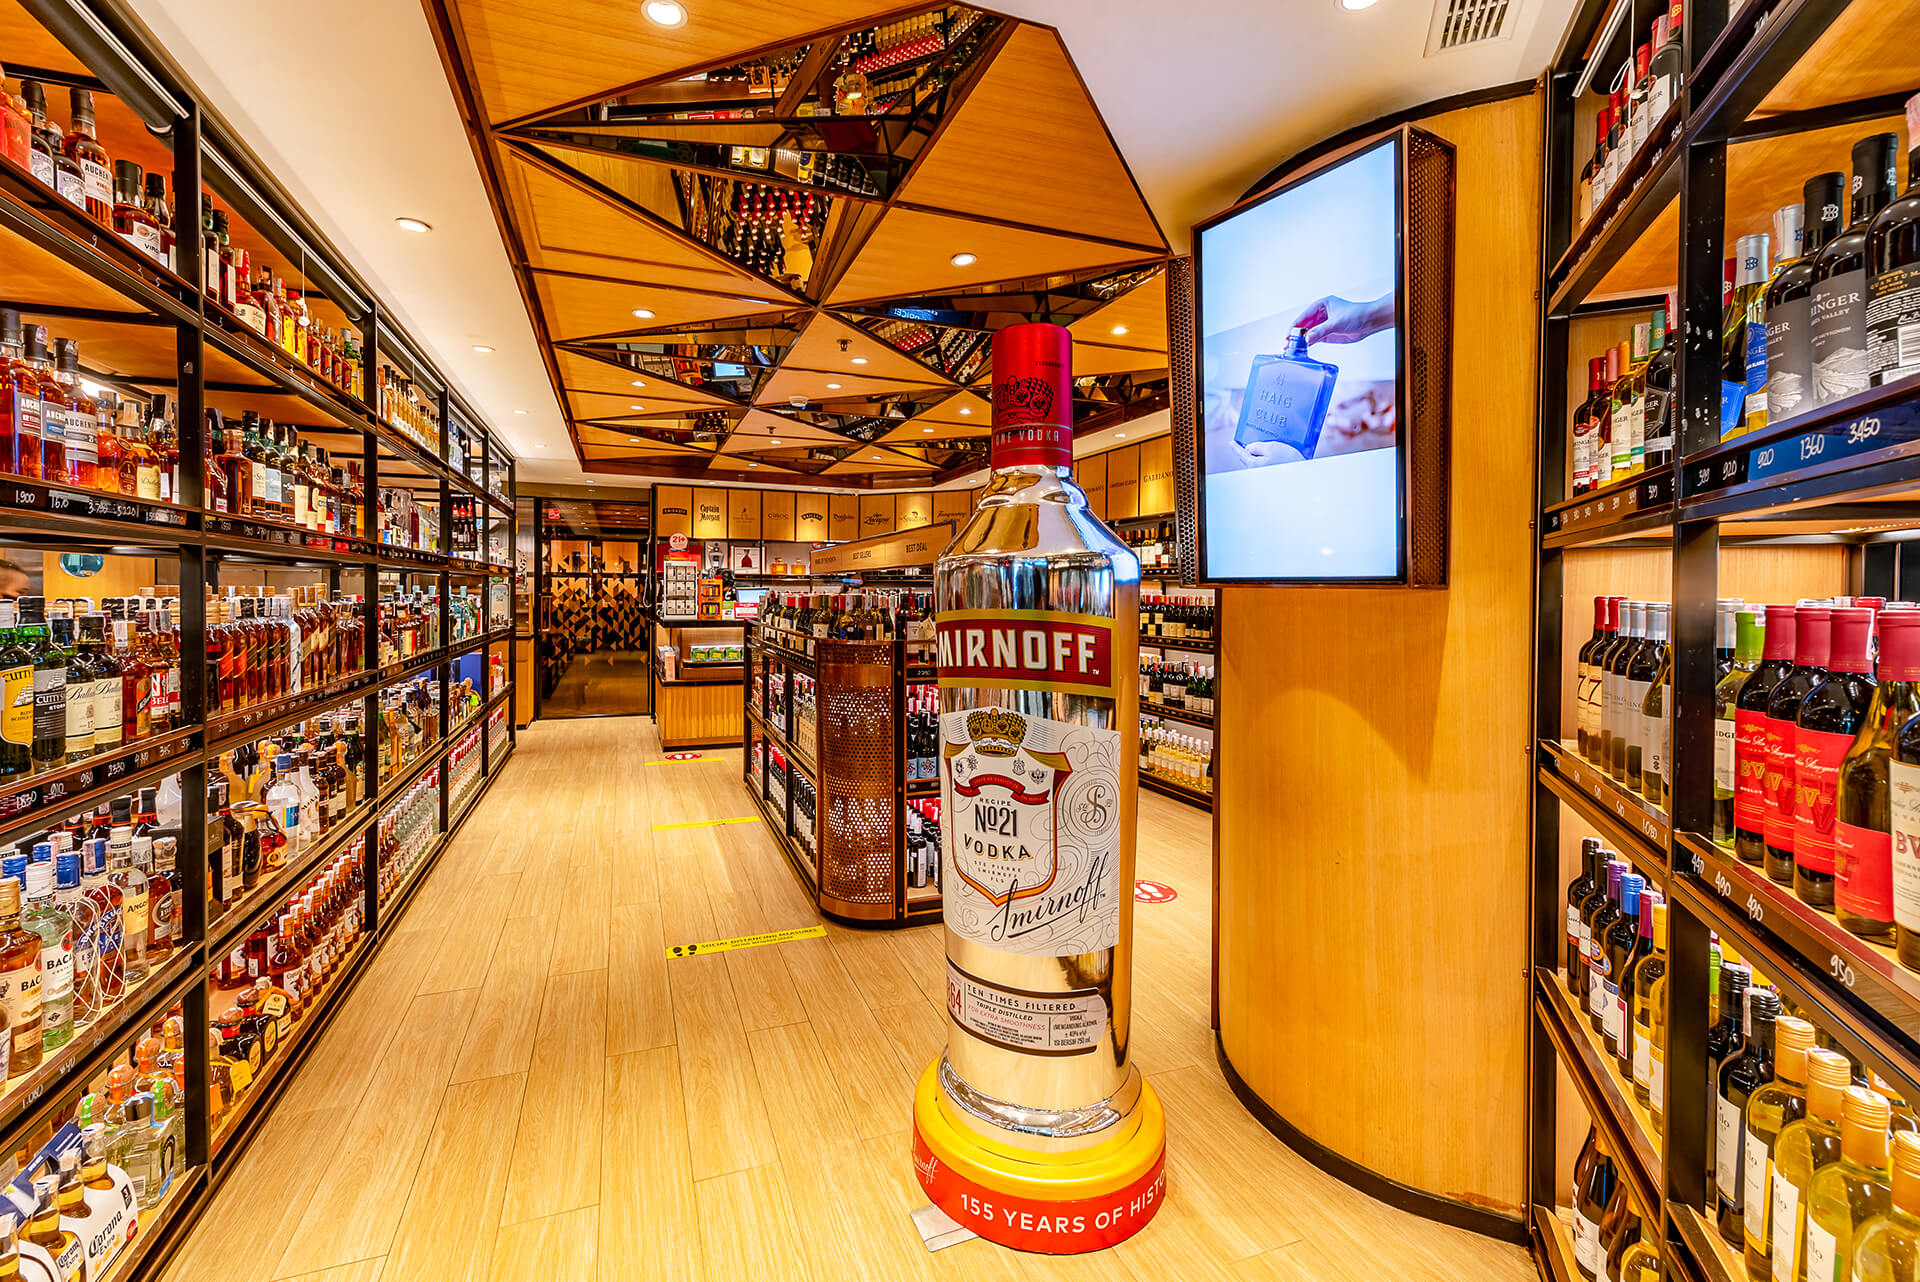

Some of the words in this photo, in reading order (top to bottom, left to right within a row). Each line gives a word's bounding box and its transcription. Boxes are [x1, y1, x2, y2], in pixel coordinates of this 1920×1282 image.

[1260, 389, 1292, 409] HAIG
[1256, 407, 1288, 428] CLUB
[1018, 429, 1059, 442] VODKA
[1758, 447, 1775, 469] 920
[699, 513, 721, 522] Morgan
[700, 504, 720, 513] Captain
[906, 543, 916, 553] BEST
[916, 542, 928, 552] DEAL
[1588, 678, 1602, 707] 7
[1740, 759, 1766, 780] BV
[980, 797, 1012, 806] RECIPE
[963, 833, 1035, 861] VODKA
[991, 863, 1021, 873] PIERRE
[986, 852, 1109, 941] Smirnoff
[701, 940, 728, 949] SOCIAL
[730, 933, 777, 945] DISTANCING
[778, 928, 818, 937] MEASURES
[1715, 871, 1731, 896] 490
[1746, 893, 1764, 922] 490
[1830, 953, 1855, 988] 950
[967, 984, 984, 997] TEN
[990, 994, 1020, 1008] TIMES
[1025, 1002, 1076, 1011] FILTERED
[976, 1001, 997, 1014] TRIPLE
[998, 1009, 1033, 1021] DISTILLED
[979, 1009, 999, 1021] EXTRA
[1000, 1015, 1046, 1031] SMOOTHNESS
[961, 1193, 994, 1220] 155
[1003, 1208, 1085, 1233] YEARS
[1095, 1206, 1123, 1229] OF
[89, 1210, 123, 1259] Corona
[97, 1234, 116, 1255] Extra
[58, 1240, 80, 1268] Corona
